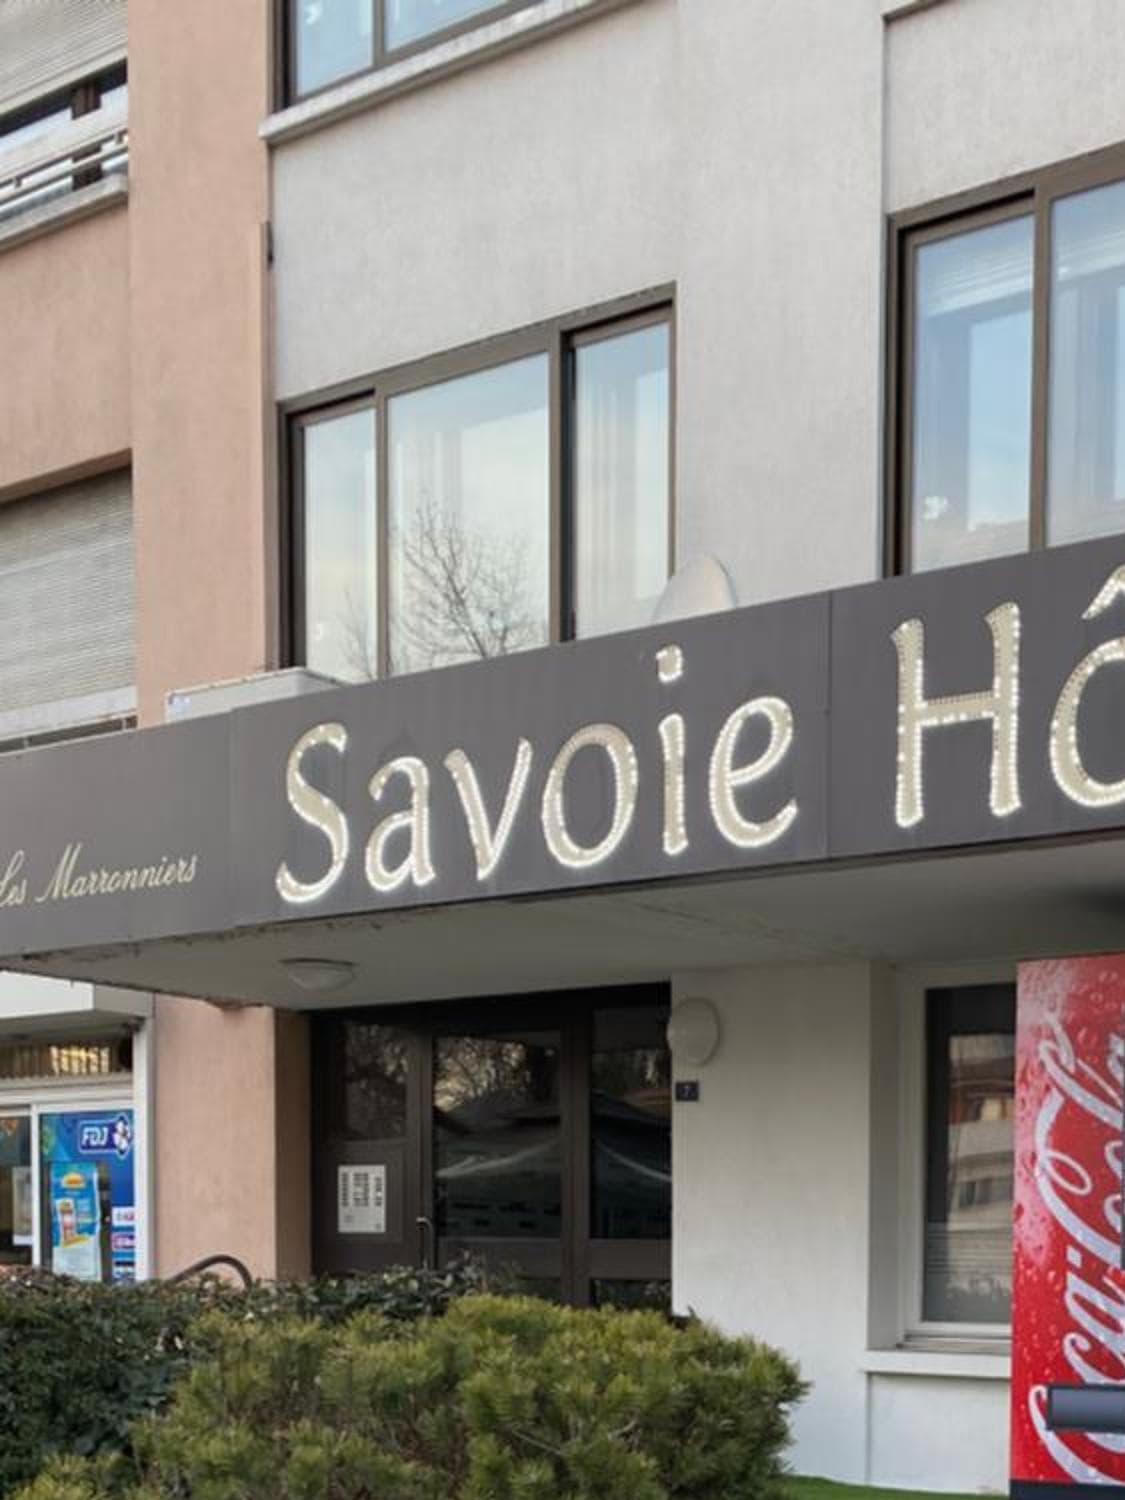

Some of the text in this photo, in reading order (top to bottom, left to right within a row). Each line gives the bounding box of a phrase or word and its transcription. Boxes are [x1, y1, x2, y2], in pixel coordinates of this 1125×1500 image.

[275, 643, 798, 906] Savoie
[35, 842, 198, 903] Marronniers
[81, 1126, 109, 1147] FDJ
